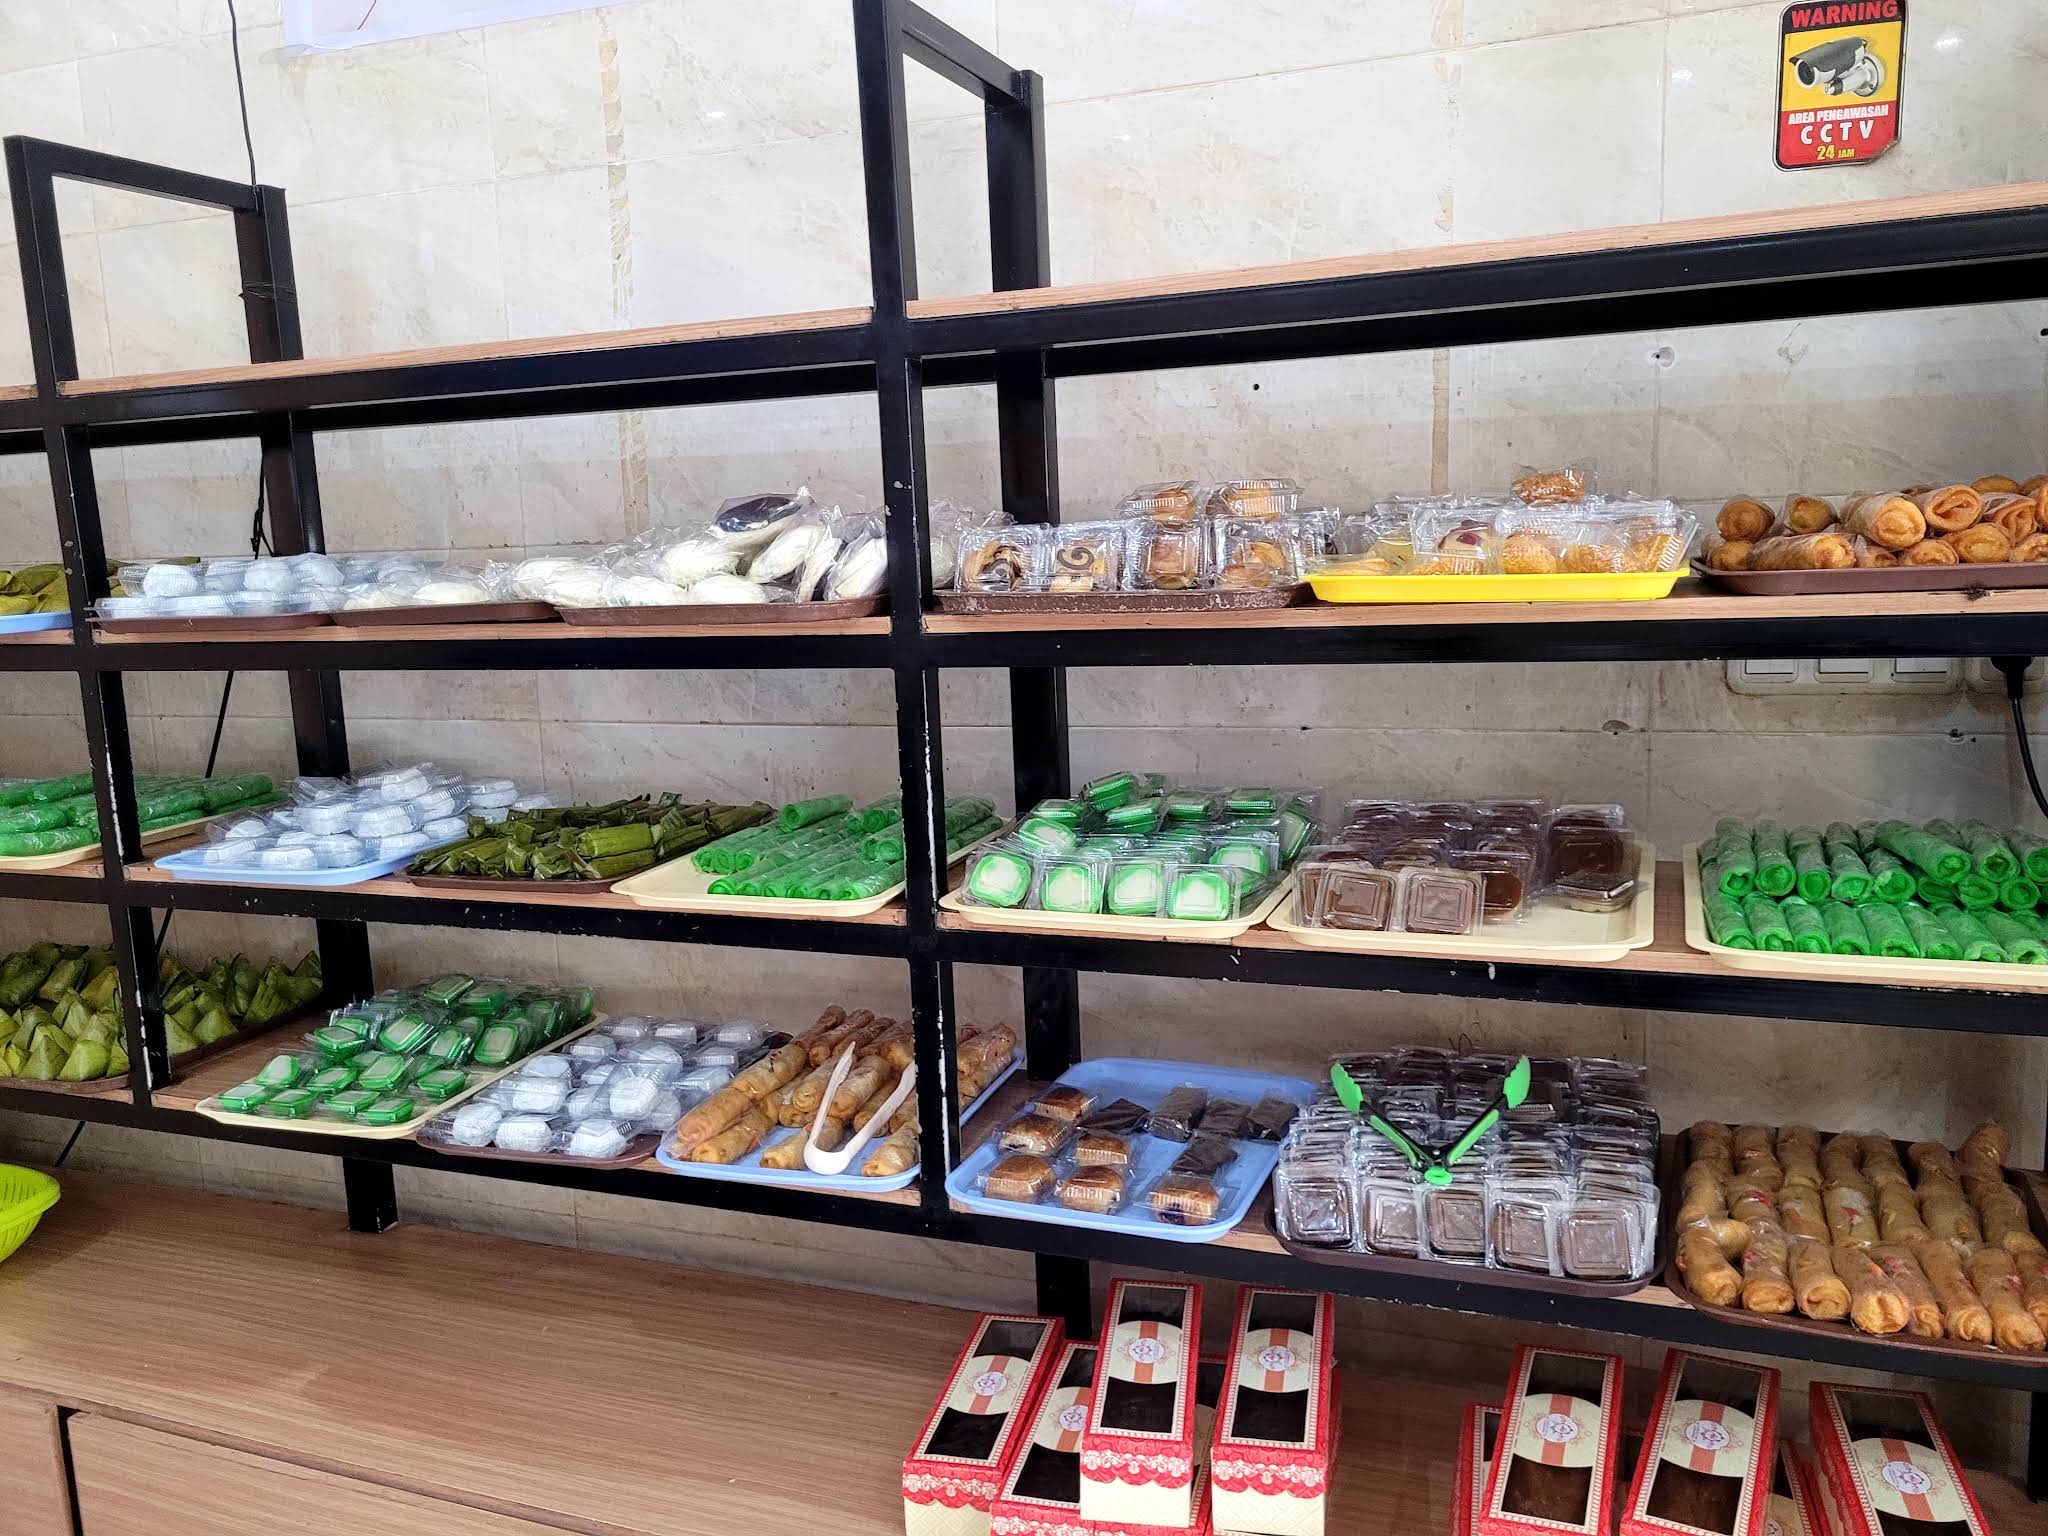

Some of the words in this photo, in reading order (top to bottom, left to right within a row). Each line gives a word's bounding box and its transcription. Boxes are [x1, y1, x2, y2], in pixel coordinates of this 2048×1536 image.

[1791, 0, 1898, 29] WARNING
[1788, 112, 1815, 125] AREA
[1816, 104, 1889, 122] PENGAWASAN
[1816, 144, 1835, 160] 24
